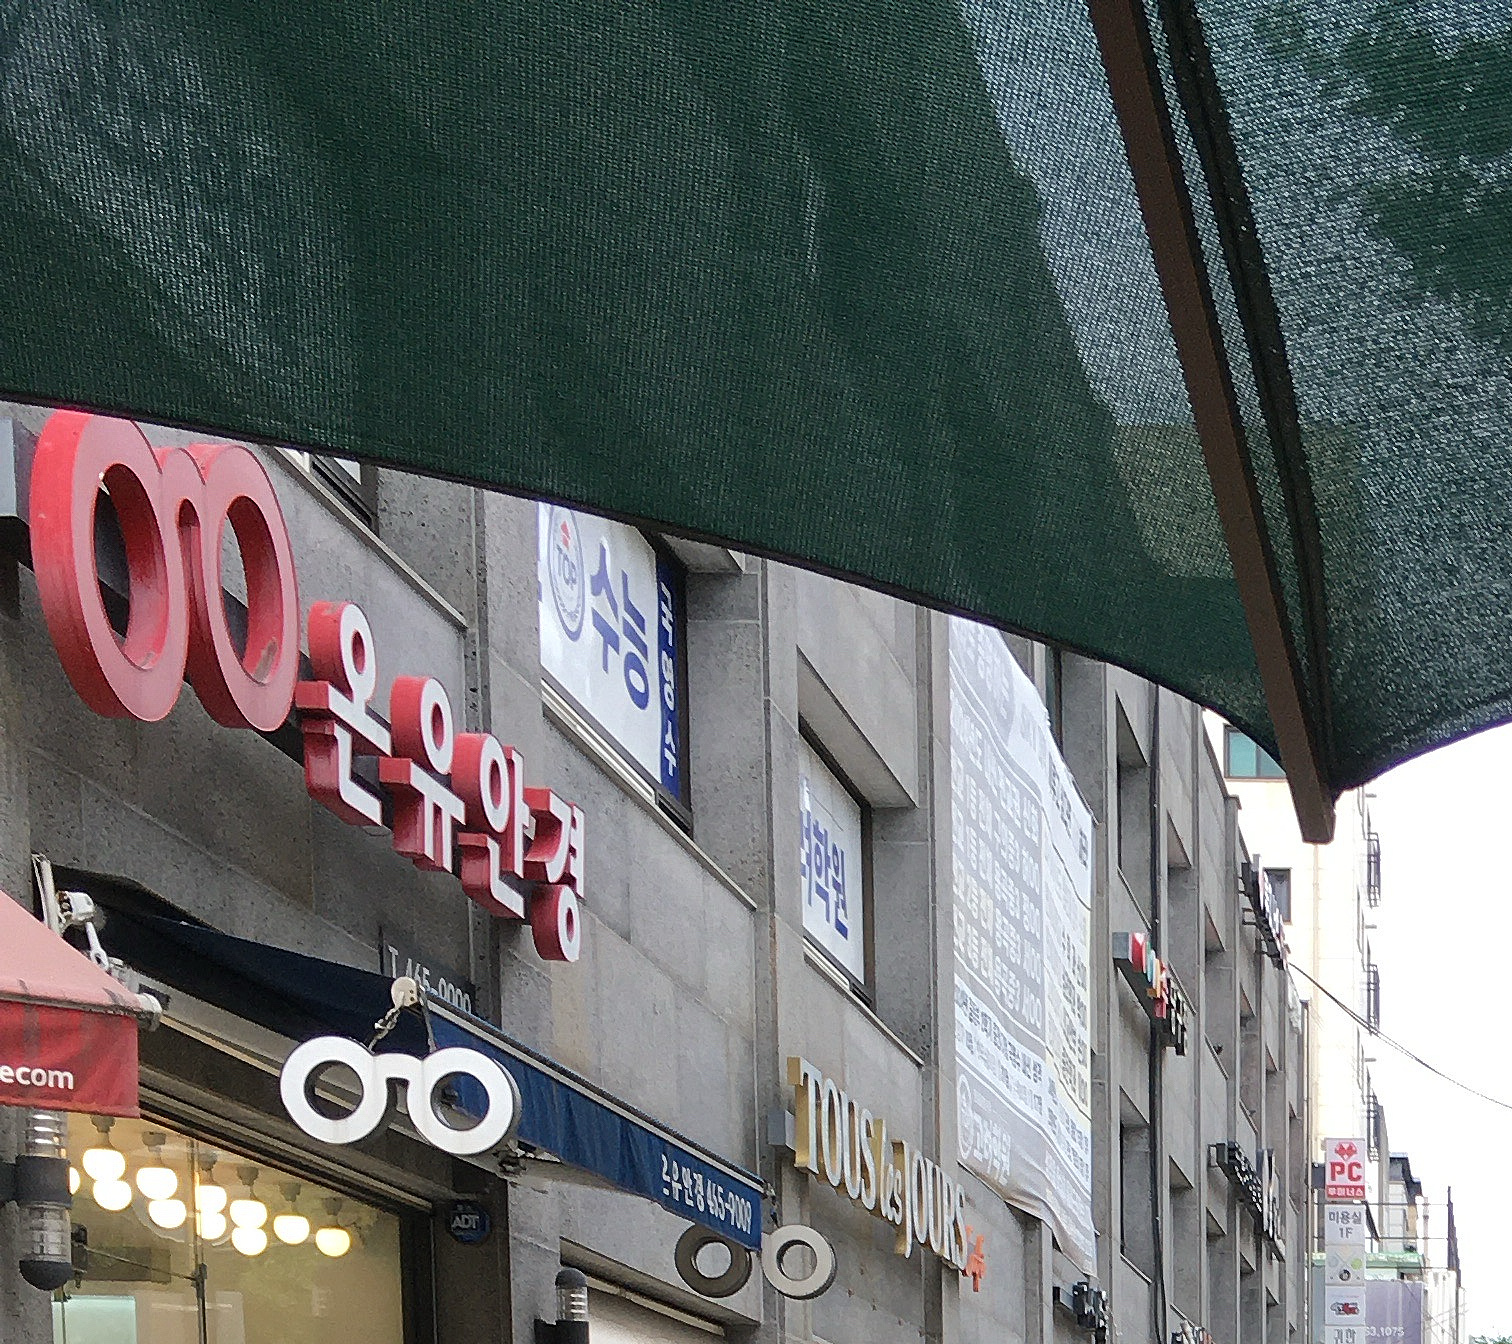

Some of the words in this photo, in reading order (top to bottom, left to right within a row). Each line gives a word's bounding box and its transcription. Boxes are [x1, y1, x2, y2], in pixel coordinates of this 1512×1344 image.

[590, 540, 650, 711] 수능
[296, 600, 586, 961] 온유안경
[787, 1056, 877, 1211] TOUS
[874, 1119, 902, 1226] les
[894, 1139, 970, 1273] JOURS
[1330, 1161, 1362, 1182] PC
[451, 1214, 480, 1229] ADT
[1328, 1210, 1362, 1225] 미용실
[1338, 1227, 1354, 1239] 1F
